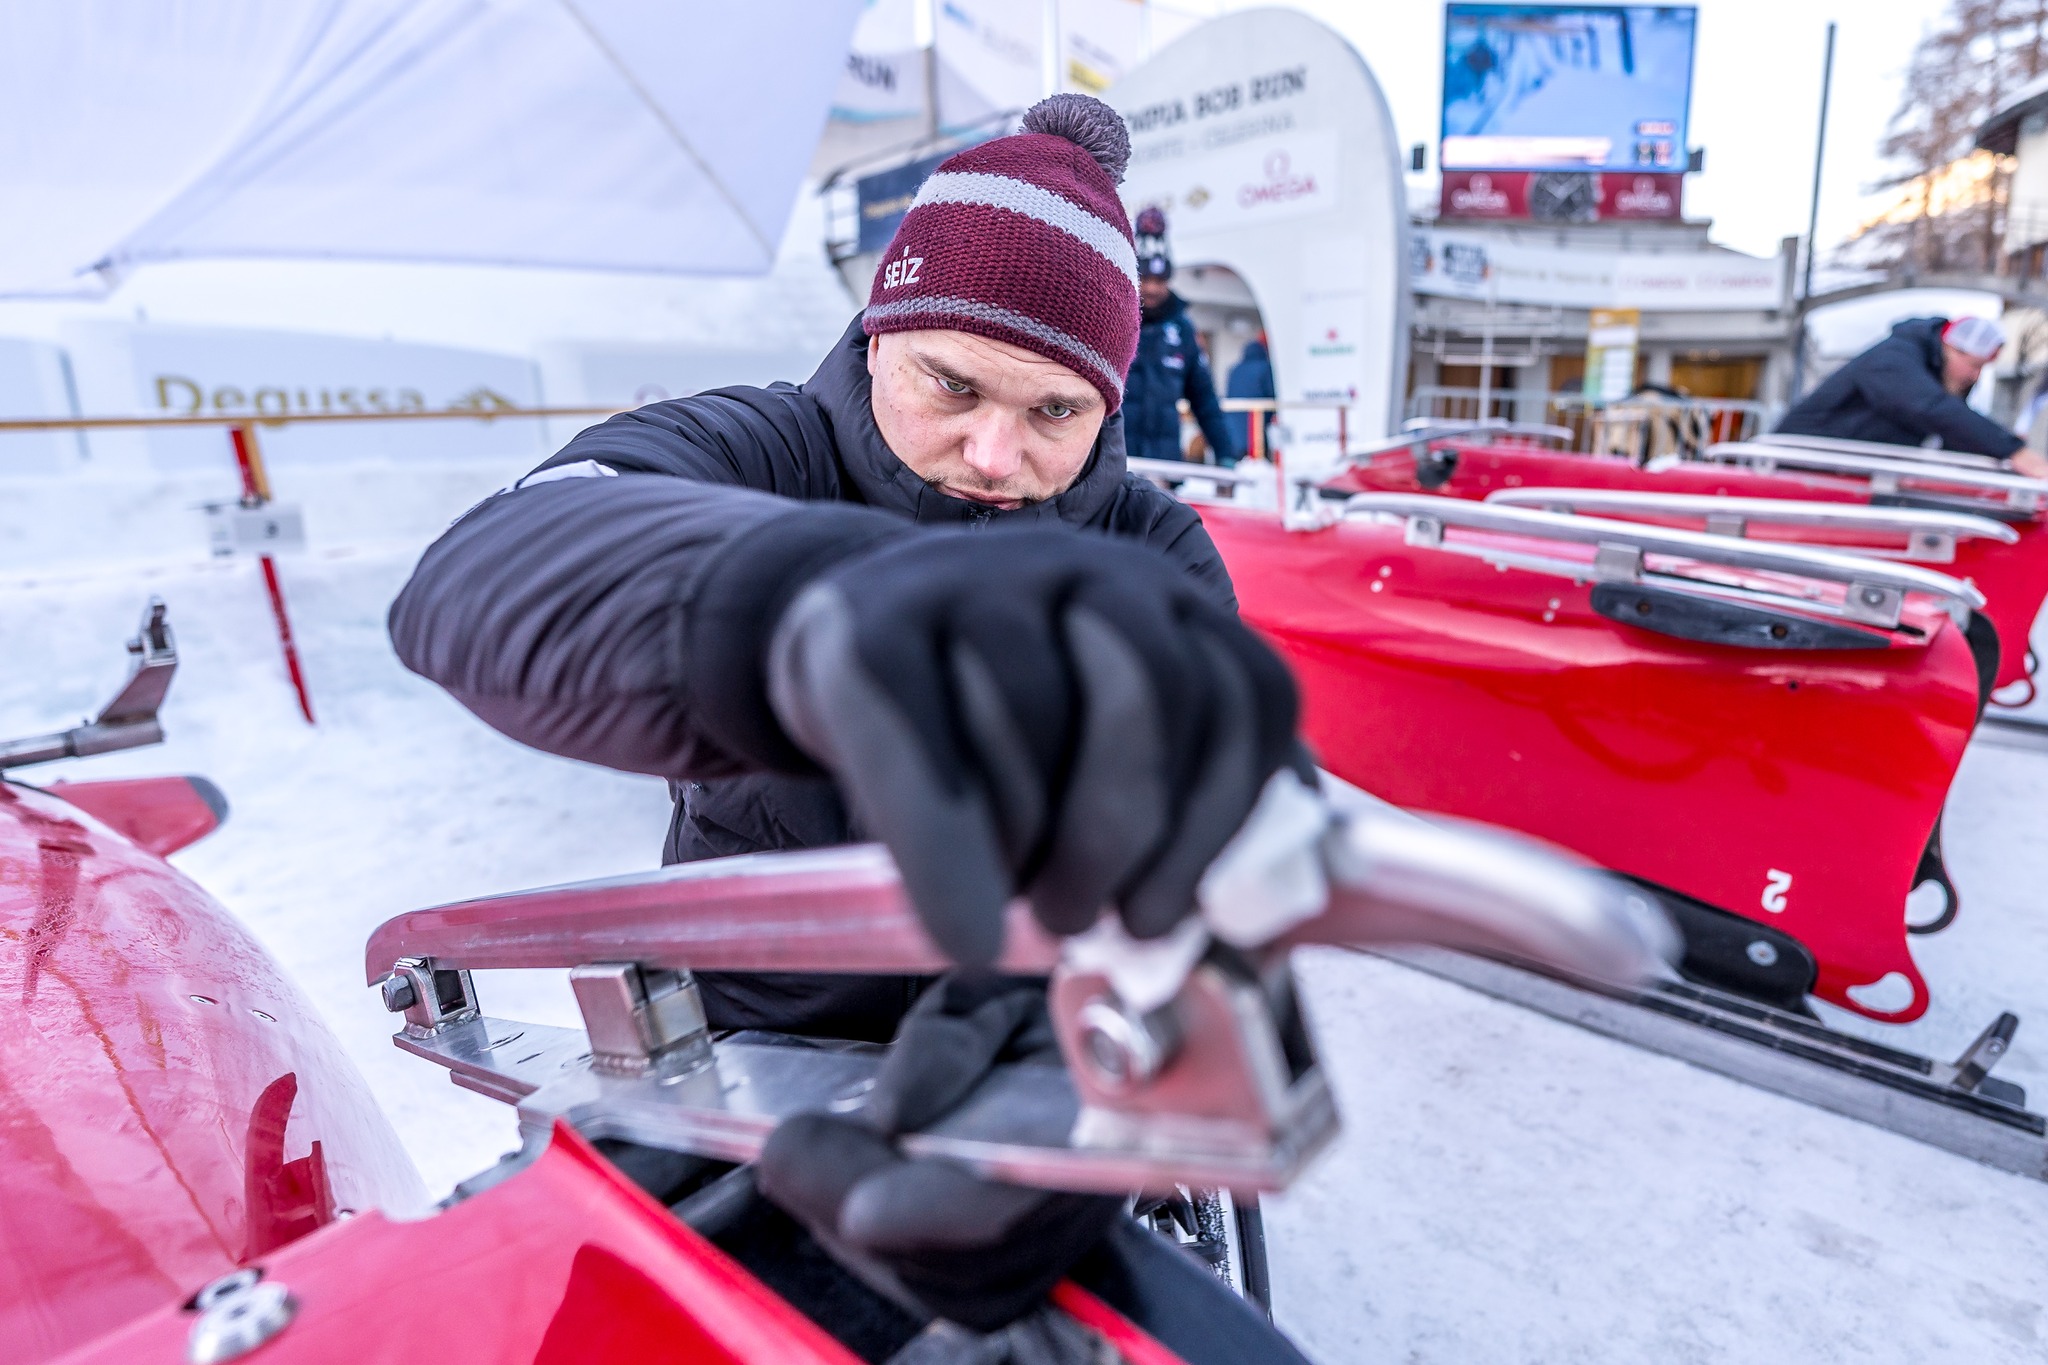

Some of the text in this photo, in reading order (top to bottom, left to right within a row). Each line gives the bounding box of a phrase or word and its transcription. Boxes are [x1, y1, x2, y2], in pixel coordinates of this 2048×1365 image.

[1127, 65, 1307, 132] MPIA BOB RUN
[1239, 175, 1317, 209] OMEGA
[155, 374, 426, 431] Degussa
[1761, 868, 1793, 914] 2
